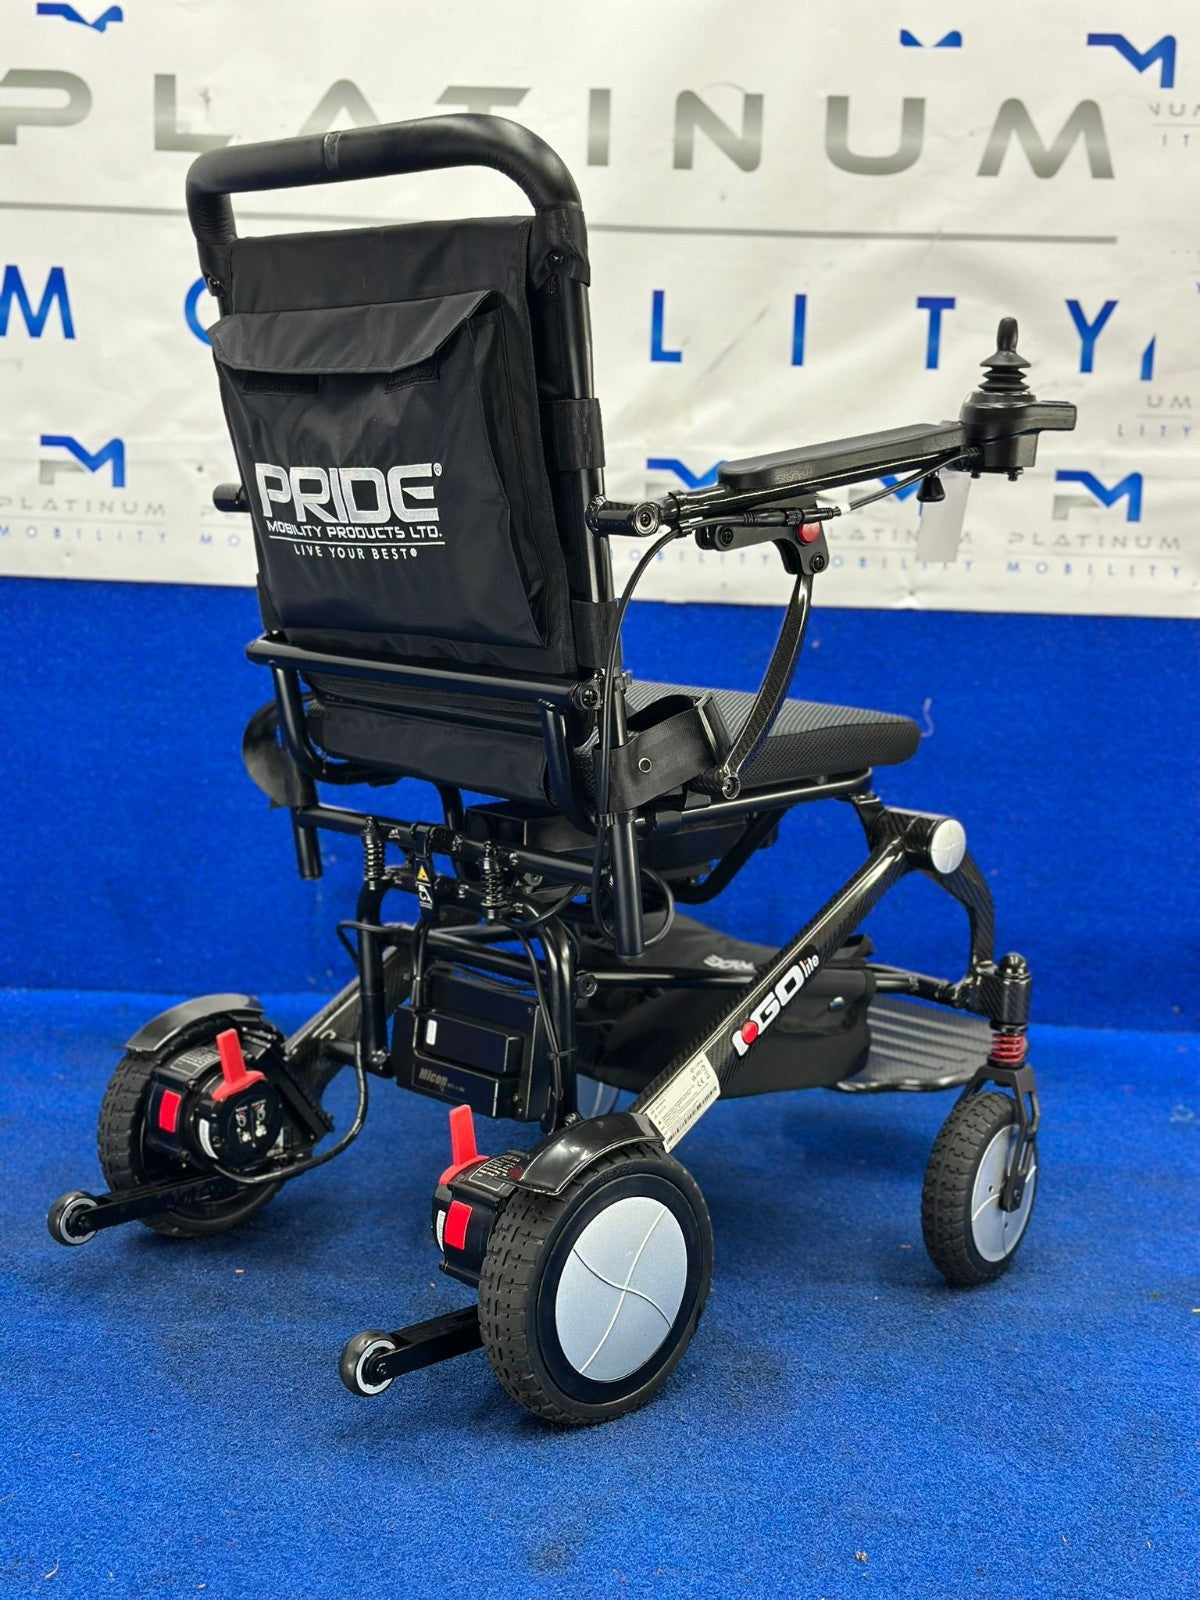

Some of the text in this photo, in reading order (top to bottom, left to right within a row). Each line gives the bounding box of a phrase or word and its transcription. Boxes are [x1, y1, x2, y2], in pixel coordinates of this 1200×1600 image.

[0, 263, 1119, 374] MLITY
[0, 526, 167, 543] MOBILITY
[265, 519, 443, 539] MOBILITY PRODUCTS LTD.
[1008, 532, 1181, 550] PLATINUM
[293, 543, 323, 558] LIVE
[328, 546, 366, 560] YOUR
[1007, 561, 1181, 579] MOBILITY
